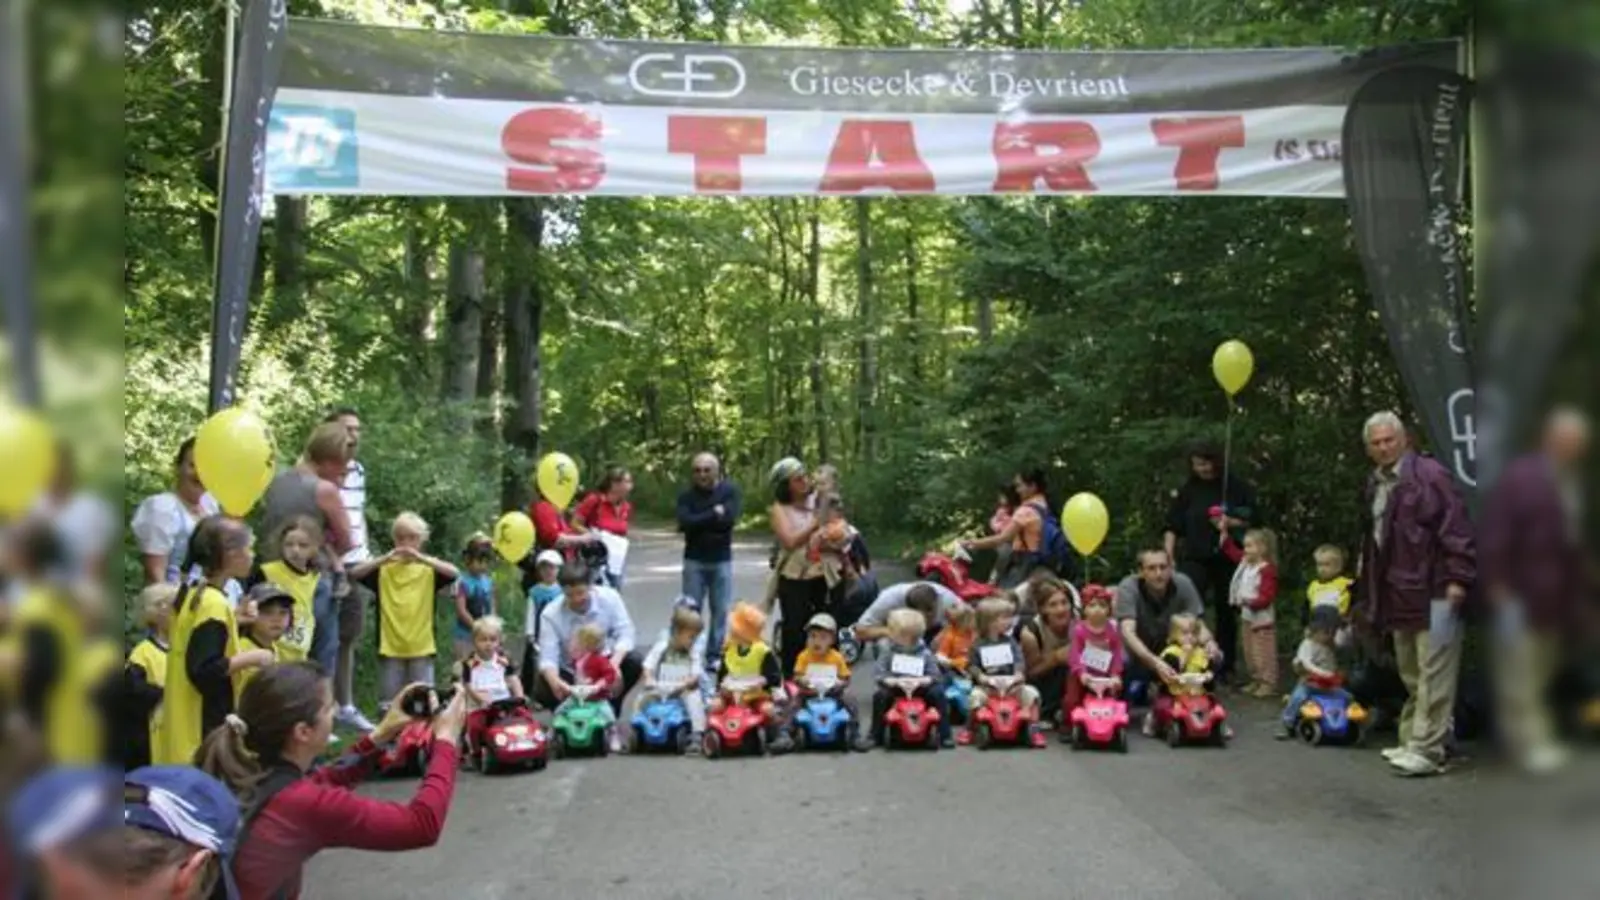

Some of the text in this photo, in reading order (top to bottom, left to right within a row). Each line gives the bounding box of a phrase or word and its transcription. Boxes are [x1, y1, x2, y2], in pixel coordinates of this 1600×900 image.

[789, 65, 1130, 98] Giesecke & Devrient
[501, 106, 1246, 194] START
